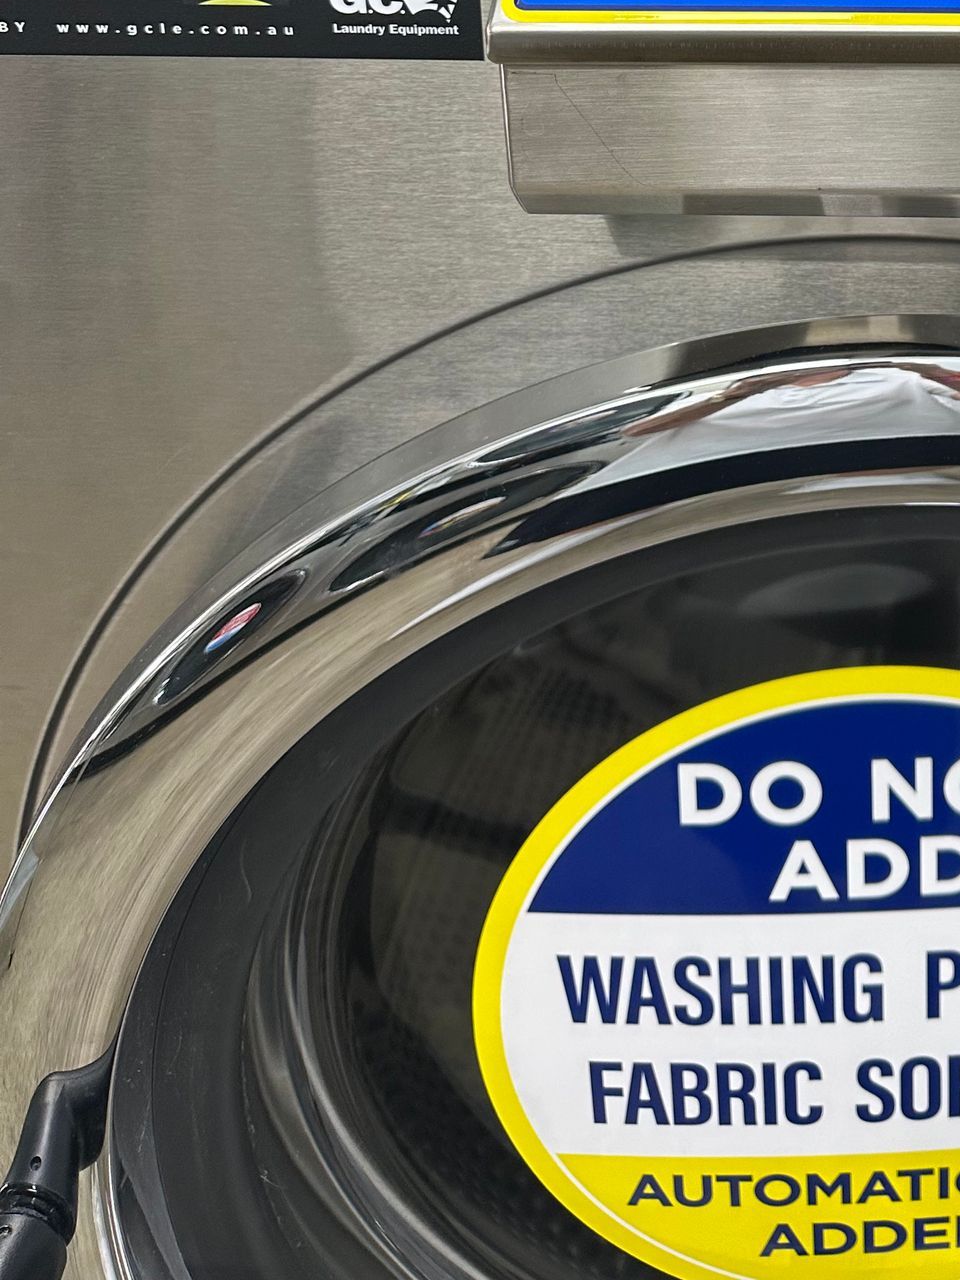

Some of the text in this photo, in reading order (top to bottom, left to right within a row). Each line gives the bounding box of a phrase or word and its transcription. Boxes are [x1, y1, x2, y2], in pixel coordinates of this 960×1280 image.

[56, 23, 294, 36] www.gcle.com.au
[333, 23, 459, 36] Laundry Equipment
[677, 760, 822, 827] DO
[557, 954, 884, 1026] WASHING
[588, 1061, 822, 1126] FABRIC
